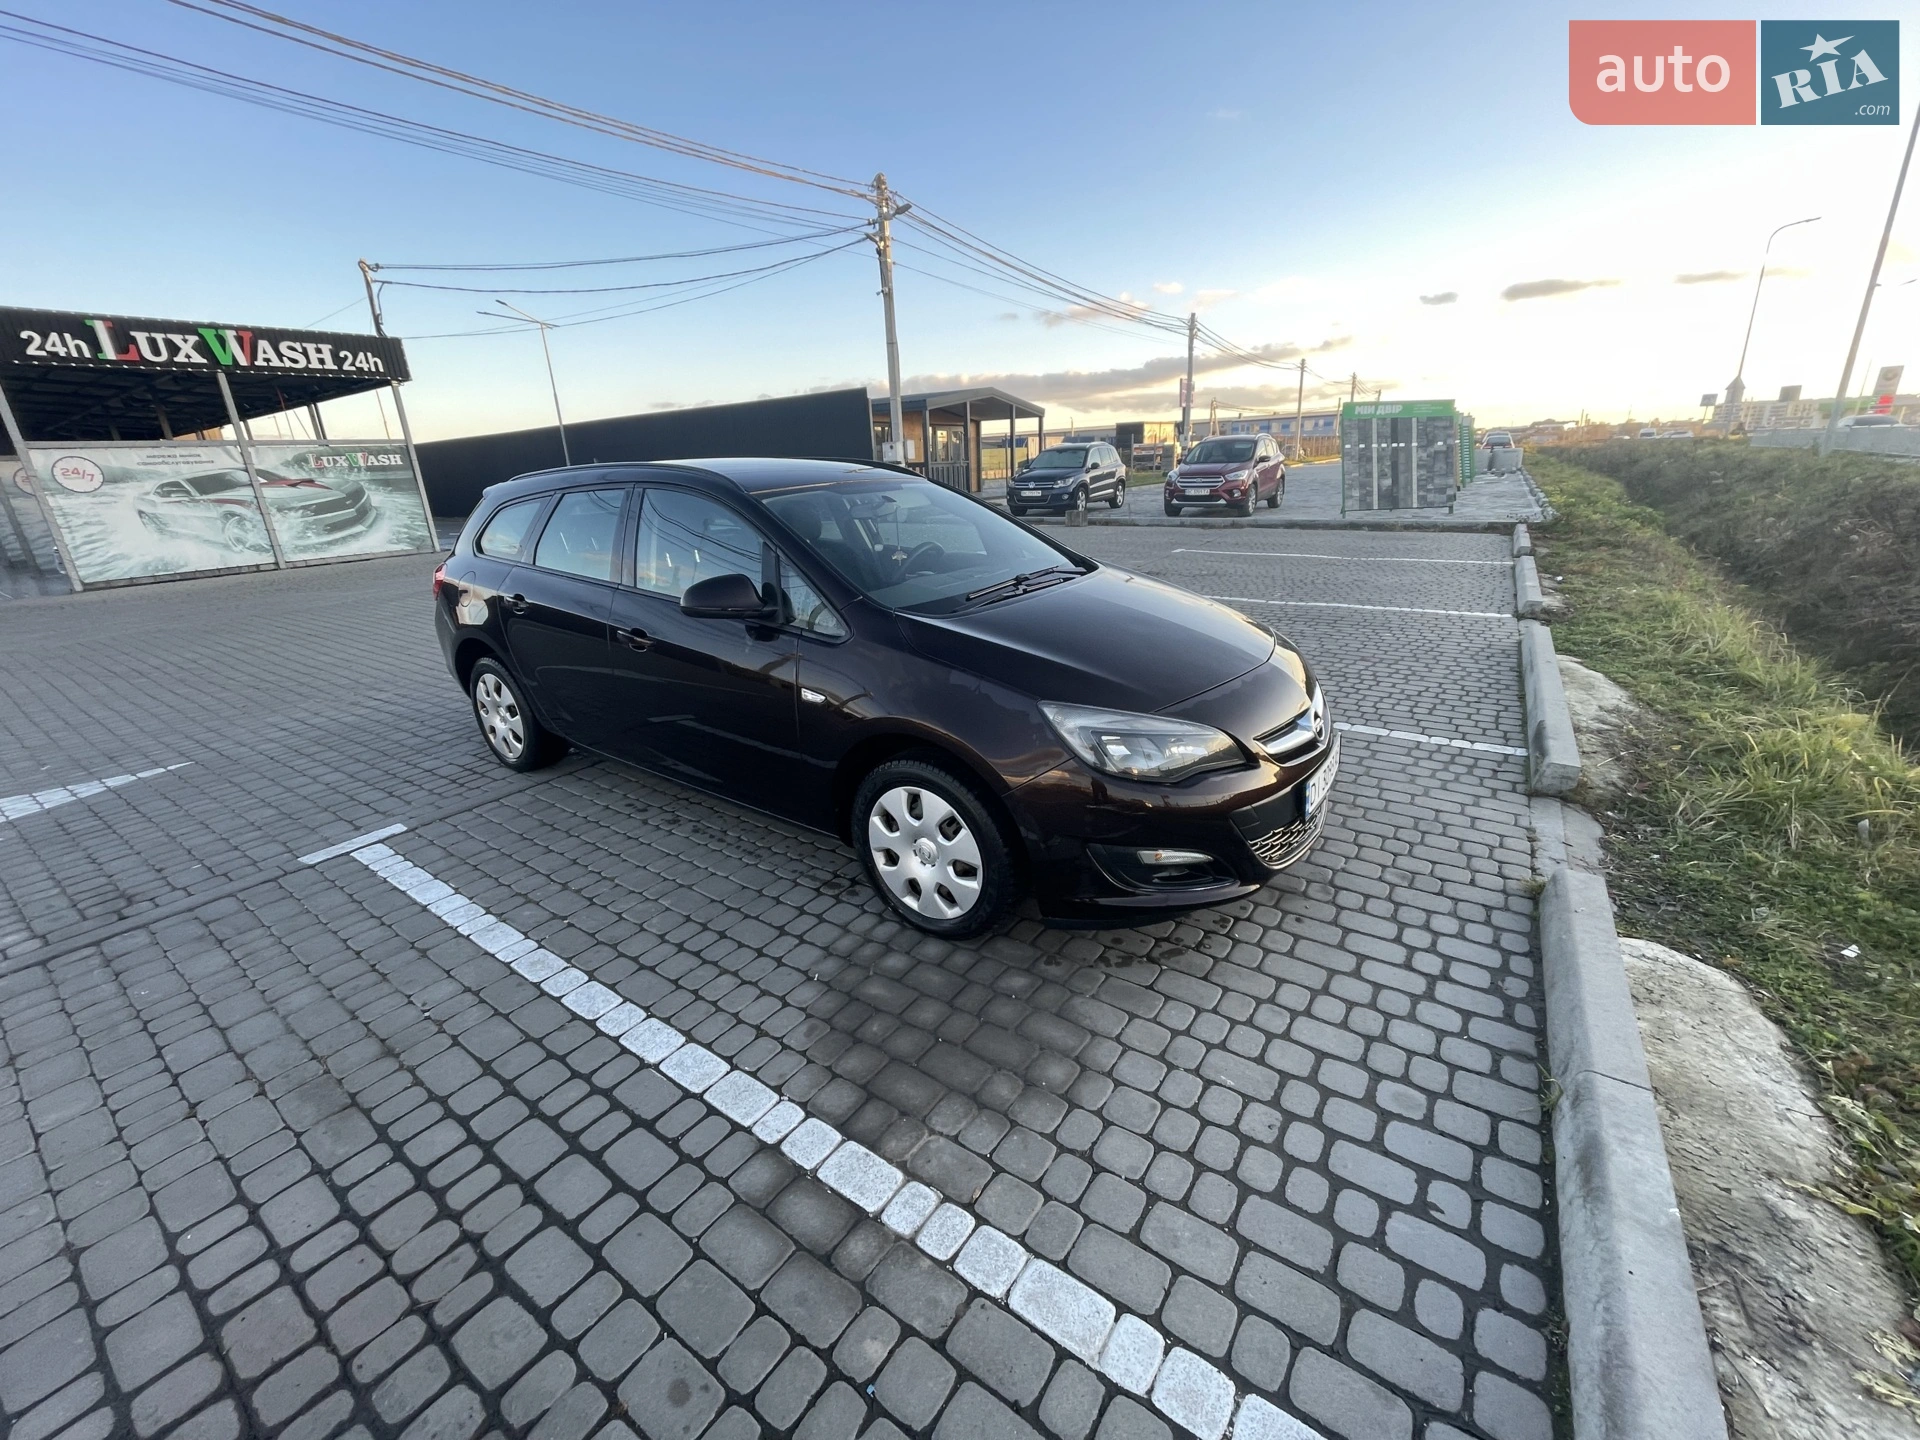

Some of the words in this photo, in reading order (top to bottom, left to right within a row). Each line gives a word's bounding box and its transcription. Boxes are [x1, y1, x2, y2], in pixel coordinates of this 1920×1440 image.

[19, 330, 92, 359] 24h
[339, 350, 385, 373] 24h
[60, 467, 95, 482] 24/7
